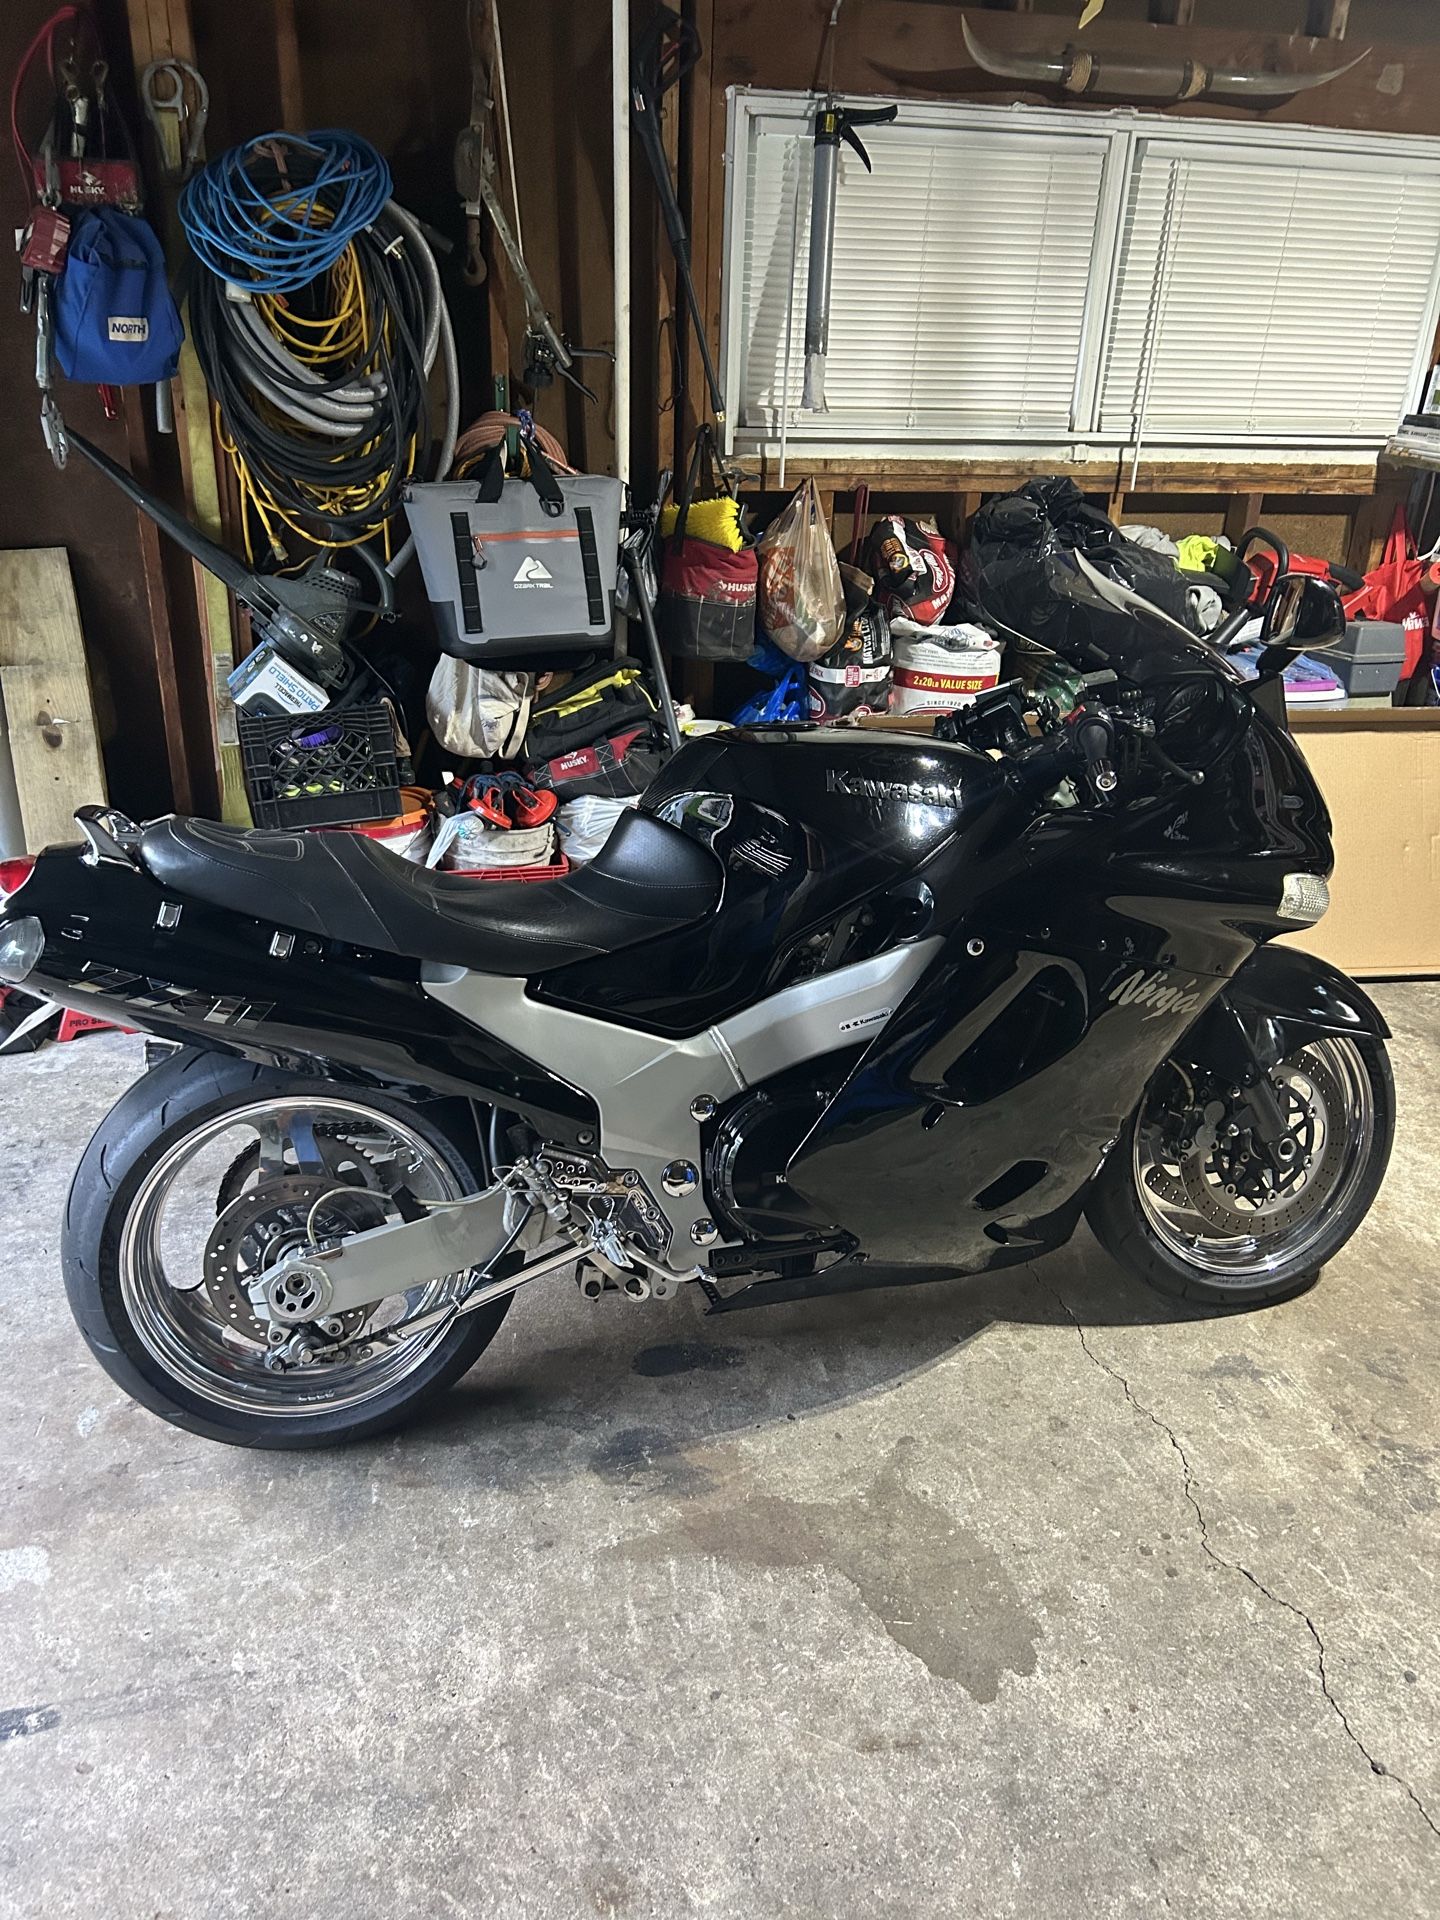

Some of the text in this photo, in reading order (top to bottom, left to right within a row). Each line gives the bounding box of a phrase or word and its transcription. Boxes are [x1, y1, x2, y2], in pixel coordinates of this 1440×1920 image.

[112, 323, 146, 334] NORTH
[863, 634, 873, 663] MATCH
[268, 665, 298, 693] SHIELD
[940, 679, 966, 690] VALUE
[967, 680, 982, 690] SIZE
[273, 682, 302, 707] THERMACELL
[295, 688, 320, 711] PATIO
[560, 755, 587, 770] HUSKY
[826, 769, 963, 808] Kawasaki
[1108, 969, 1200, 1021] Ninja
[70, 1019, 89, 1028] PRO
